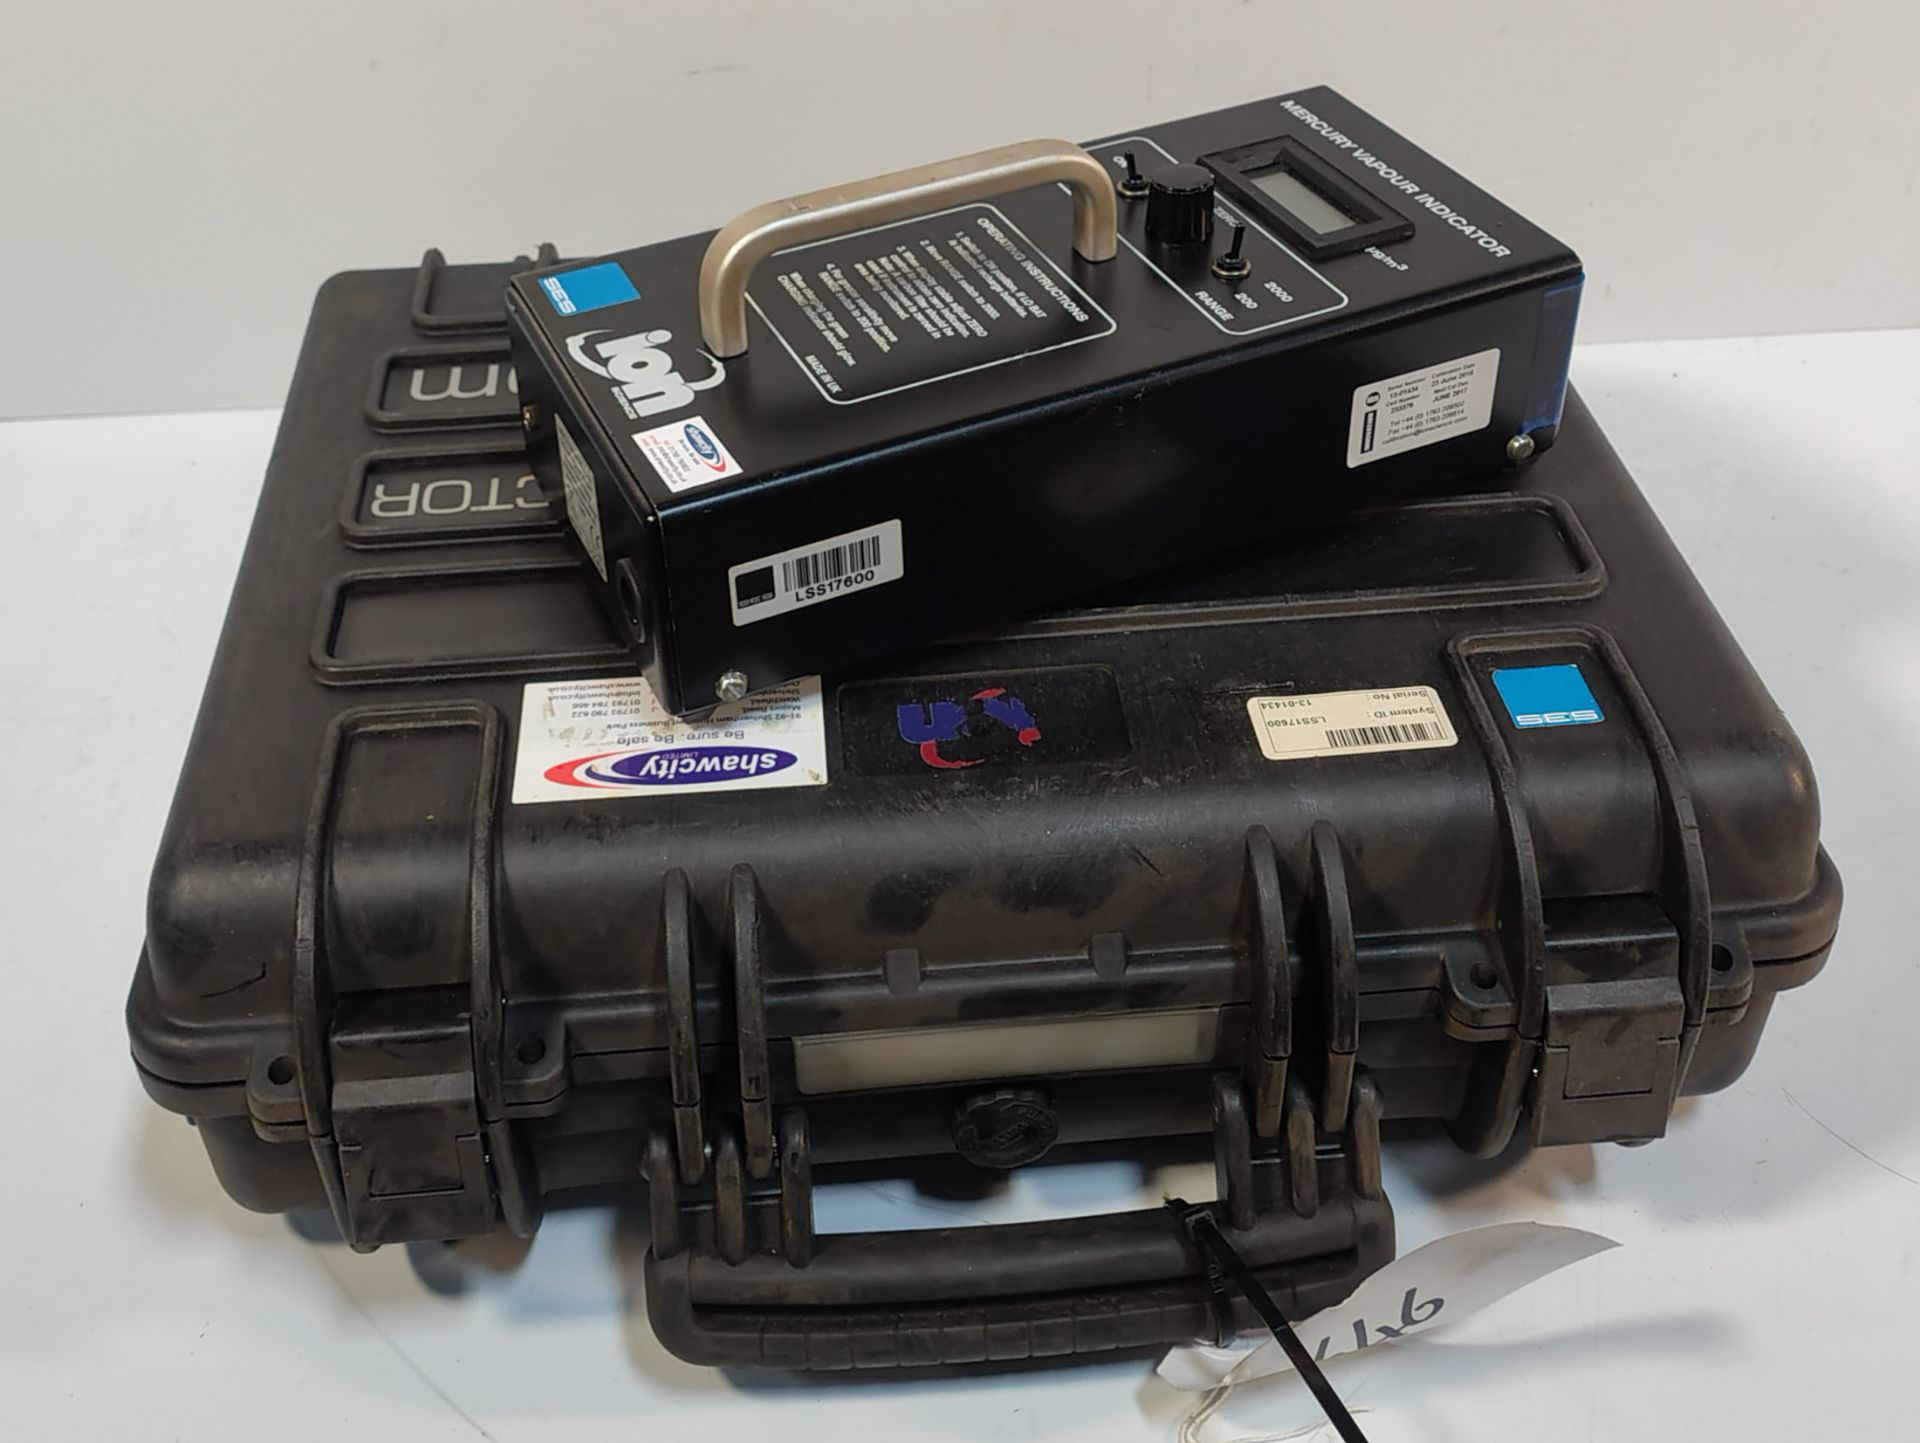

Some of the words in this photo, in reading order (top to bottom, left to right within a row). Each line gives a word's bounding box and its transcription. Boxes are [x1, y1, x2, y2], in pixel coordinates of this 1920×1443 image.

[1280, 100, 1358, 150] MERCURY
[1352, 148, 1420, 195] VAPOUR
[1414, 193, 1511, 259] INDICATOR
[974, 216, 1028, 261] OPERATING
[1017, 260, 1092, 322] INSTRUCTIONS
[543, 277, 577, 315] SES
[1264, 281, 1293, 303] 2000
[1194, 290, 1234, 322] RANGE
[1234, 292, 1258, 310] 200
[804, 353, 828, 375] MADE
[595, 329, 695, 418] ion
[819, 373, 834, 383] IN
[825, 381, 842, 393] UK
[795, 569, 875, 602] LSS17600
[1373, 692, 1391, 701] No
[1393, 689, 1428, 699] Serial
[1261, 699, 1312, 710] 13-01434
[611, 707, 641, 716] 01793
[1390, 706, 1435, 717] System
[1516, 709, 1599, 726] SES
[1267, 716, 1327, 728] LSS17600
[617, 735, 649, 747] safe
[654, 734, 675, 744] Be
[681, 731, 719, 741] sure.
[724, 730, 745, 740] Be
[639, 752, 778, 780] shawcity
